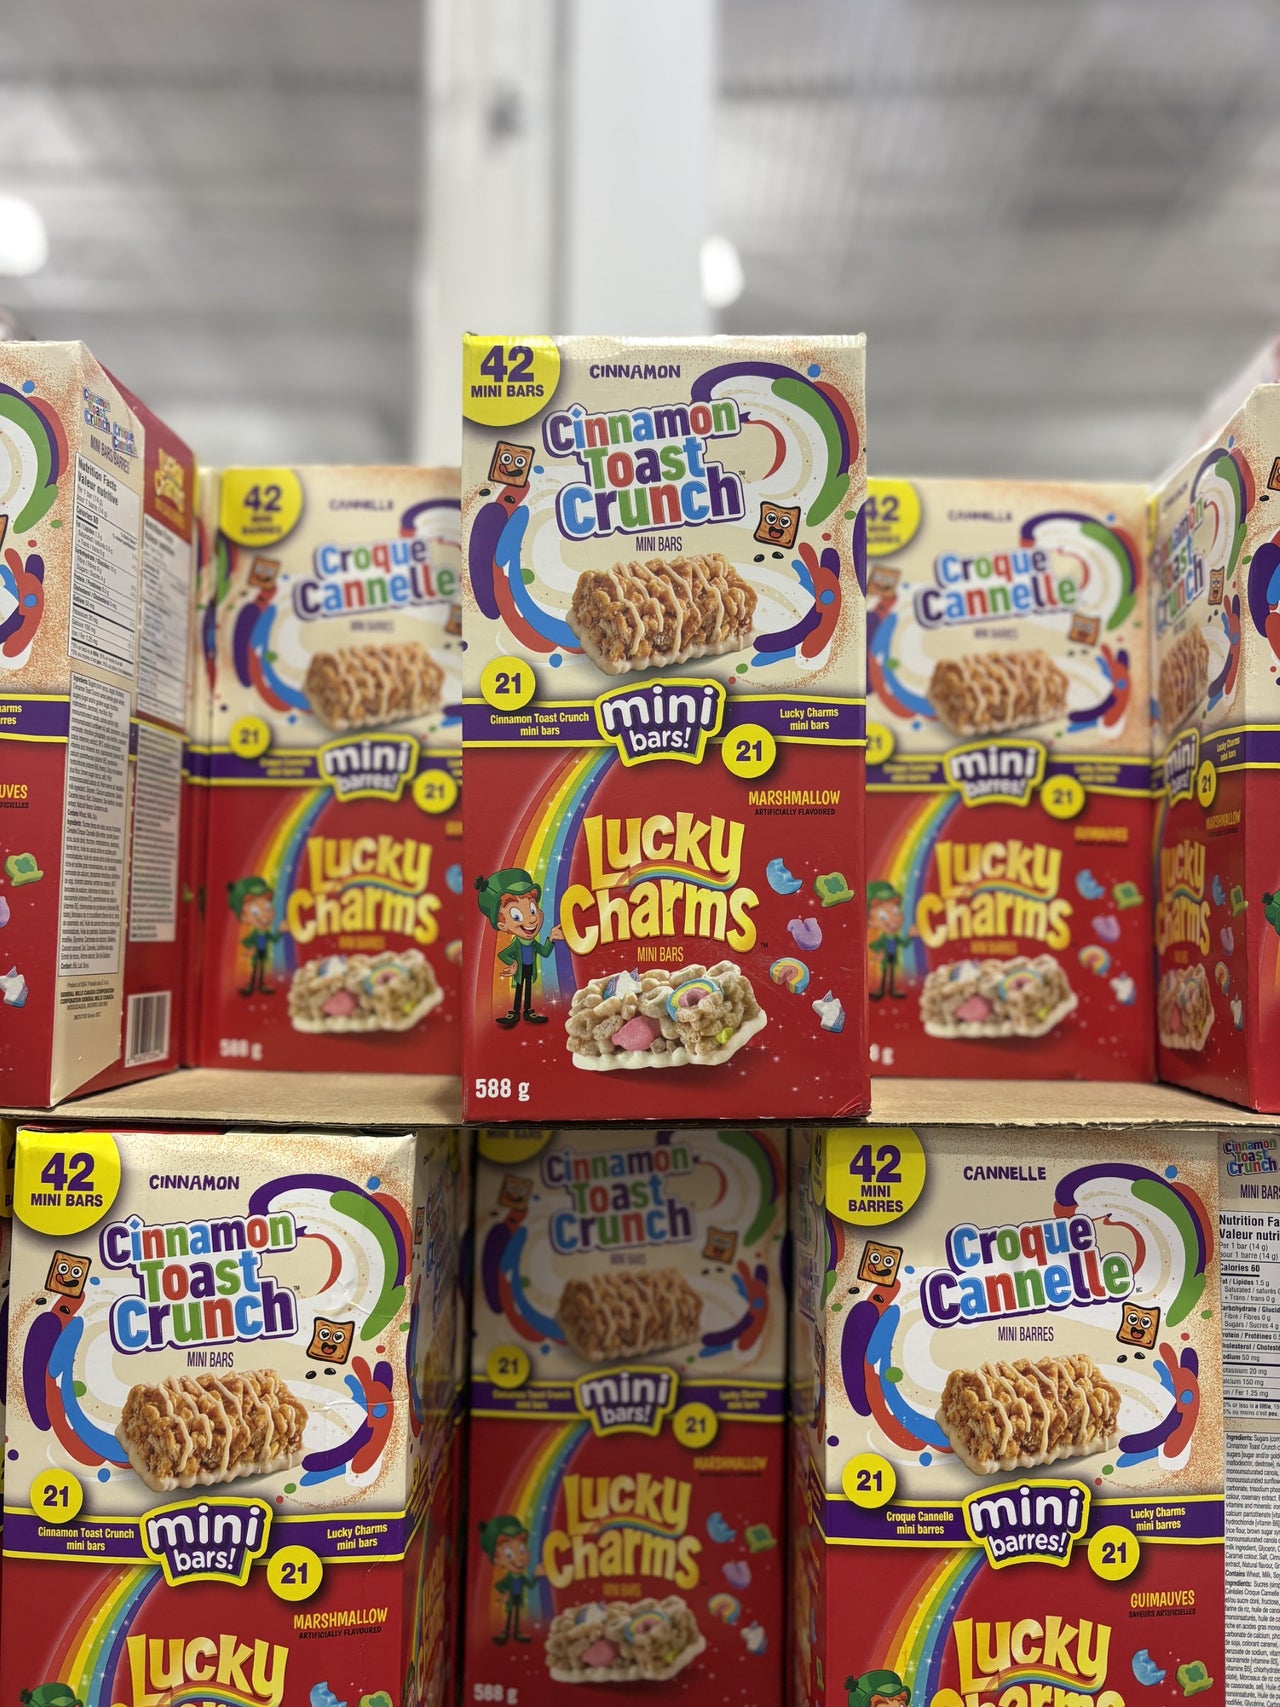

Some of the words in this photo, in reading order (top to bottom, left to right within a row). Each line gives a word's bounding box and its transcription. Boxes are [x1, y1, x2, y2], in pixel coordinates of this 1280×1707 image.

[480, 346, 534, 381] 42
[589, 365, 681, 379] CINNAMON
[471, 385, 501, 397] MINI
[506, 384, 544, 397] BARS
[546, 402, 736, 449] Cinnamon
[584, 437, 704, 489] Toast
[244, 485, 282, 512] 42
[561, 467, 741, 536] Crunch
[636, 537, 655, 552] MINI
[659, 536, 682, 552] BARS
[321, 541, 426, 574] Croque
[942, 551, 1047, 583] Croque
[300, 565, 456, 614] Cannelle
[922, 574, 1078, 621] Cannelle
[495, 675, 522, 694] 21
[0, 705, 22, 713] arms
[602, 686, 714, 730] mini
[780, 708, 804, 721] Lucky
[807, 707, 839, 718] Charms
[490, 714, 531, 725] Cinnamon
[534, 713, 557, 724] Toast
[560, 712, 589, 722] Crunch
[790, 719, 807, 730] mini
[809, 719, 830, 729] bars
[240, 729, 260, 744] 21
[520, 726, 536, 736] mini
[539, 725, 560, 735] bars
[630, 728, 691, 753] bars!
[324, 740, 409, 773] mini
[736, 741, 762, 761] 21
[951, 745, 1038, 779] mini
[0, 785, 28, 799] UVES
[425, 784, 445, 799] 21
[1202, 774, 1212, 793] 21
[748, 790, 840, 806] MARSHMALLOW
[1053, 789, 1073, 805] 21
[798, 808, 835, 816] FLAVOURED
[583, 812, 745, 891] Lucky
[307, 834, 432, 895] Lucky
[935, 839, 1062, 900] Lucky
[287, 886, 442, 945] Charms
[560, 879, 759, 955] Charms
[916, 891, 1074, 950] Charms
[637, 947, 657, 962] MINI
[659, 947, 683, 962] BARS
[476, 1079, 512, 1098] 588
[518, 1081, 530, 1101] g
[1225, 1139, 1276, 1152] Cinnamon
[1235, 1149, 1267, 1162] Toast
[41, 1153, 94, 1192] 42
[547, 1147, 689, 1183] Cinnamon
[849, 1145, 901, 1183] 42
[964, 1166, 1046, 1181] CANNELLE
[1230, 1157, 1277, 1174] Crunch
[149, 1175, 240, 1191] CINNAMON
[861, 1185, 891, 1197] MINI
[1241, 1184, 1259, 1198] MINI
[31, 1194, 61, 1206] MINI
[66, 1194, 103, 1207] BARS
[572, 1174, 662, 1214] Toast
[848, 1199, 903, 1212] BARRES
[555, 1198, 691, 1250] Crunch
[1219, 1215, 1264, 1226] Nutrition
[105, 1212, 293, 1261] Cinnamon
[953, 1218, 1093, 1267] Croque
[1219, 1229, 1253, 1239] Valeur
[1257, 1230, 1280, 1240] nutri
[140, 1251, 261, 1302] Toast
[1220, 1263, 1248, 1271] Calories
[1251, 1264, 1260, 1272] 60
[930, 1251, 1130, 1321] Cannelle
[118, 1280, 296, 1349] Crunch
[998, 1327, 1017, 1342] MINI
[1020, 1327, 1054, 1342] BARRES
[187, 1352, 207, 1367] MINI
[210, 1352, 233, 1367] BARS
[498, 1357, 519, 1375] 21
[581, 1372, 669, 1408] mini
[601, 1405, 650, 1425] bars!
[686, 1417, 706, 1434] 21
[856, 1470, 883, 1492] 21
[44, 1486, 69, 1507] 21
[564, 1473, 692, 1537] Lucky
[887, 1511, 916, 1524] Croque
[918, 1511, 954, 1522] Cannelle
[971, 1487, 1080, 1532] mini
[1130, 1508, 1153, 1520] Lucky
[1155, 1506, 1186, 1519] Charms
[38, 1526, 79, 1538] Cinnamon
[81, 1527, 103, 1539] Toast
[105, 1527, 134, 1539] Crunch
[148, 1505, 260, 1548] mini
[327, 1526, 353, 1539] Lucky
[355, 1523, 388, 1537] Charms
[897, 1524, 914, 1535] mini
[916, 1524, 944, 1535] barres
[1136, 1520, 1153, 1531] mini
[1155, 1518, 1181, 1530] barres
[67, 1540, 83, 1550] mini
[86, 1540, 105, 1551] bars
[337, 1539, 355, 1550] mini
[357, 1537, 378, 1549] bars
[989, 1532, 1066, 1557] barres!
[1102, 1542, 1127, 1563] 21
[174, 1548, 233, 1571] bars!
[543, 1528, 702, 1590] Charms
[281, 1562, 307, 1584] 21
[1130, 1590, 1195, 1608] GUIMAUVES
[293, 1607, 388, 1629] MARSHMALLOW
[1128, 1610, 1155, 1618] SAVEURS
[1156, 1607, 1196, 1617] ARTIFICIELLES
[299, 1630, 341, 1639] ARTIFICIALLY
[343, 1626, 382, 1636] FLAVOURED
[953, 1615, 1111, 1694] Lucky
[127, 1633, 289, 1707] Lucky
[474, 1684, 503, 1701] 588
